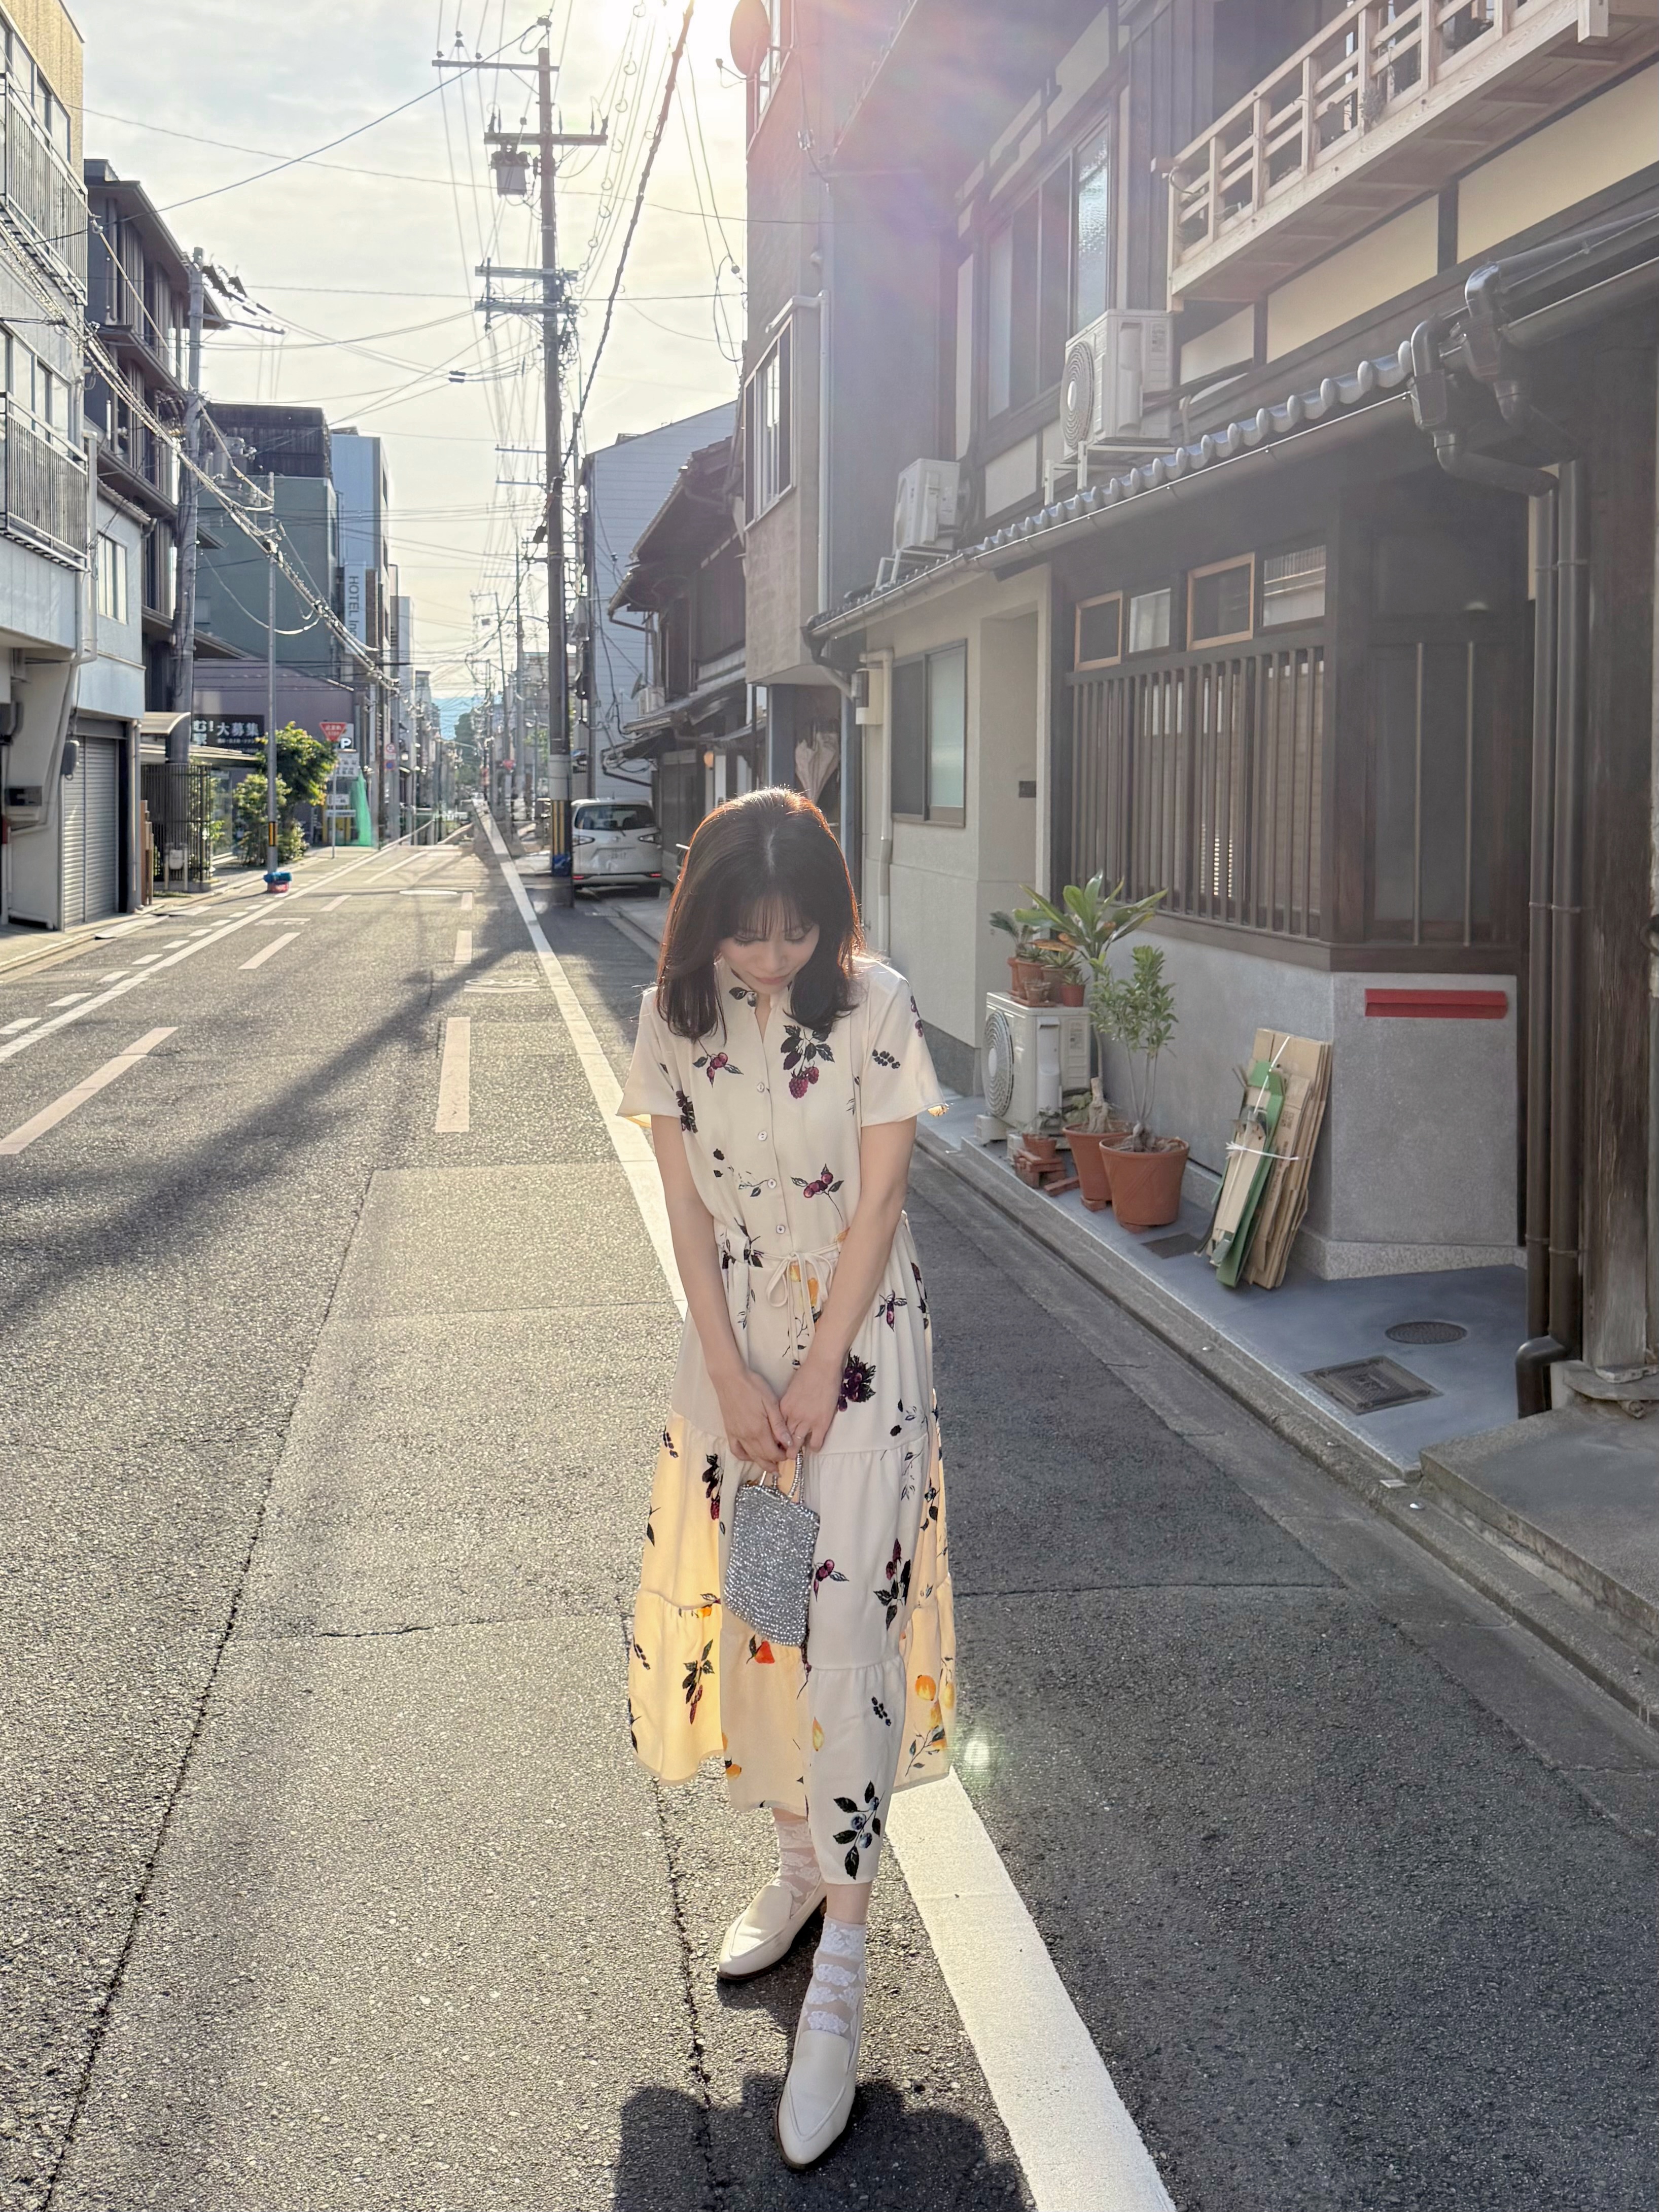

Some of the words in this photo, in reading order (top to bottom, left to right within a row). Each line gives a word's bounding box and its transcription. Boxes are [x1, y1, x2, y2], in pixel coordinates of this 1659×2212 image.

[349, 576, 359, 616] HOTEL
[217, 722, 259, 736] 大募集
[341, 738, 351, 749] P
